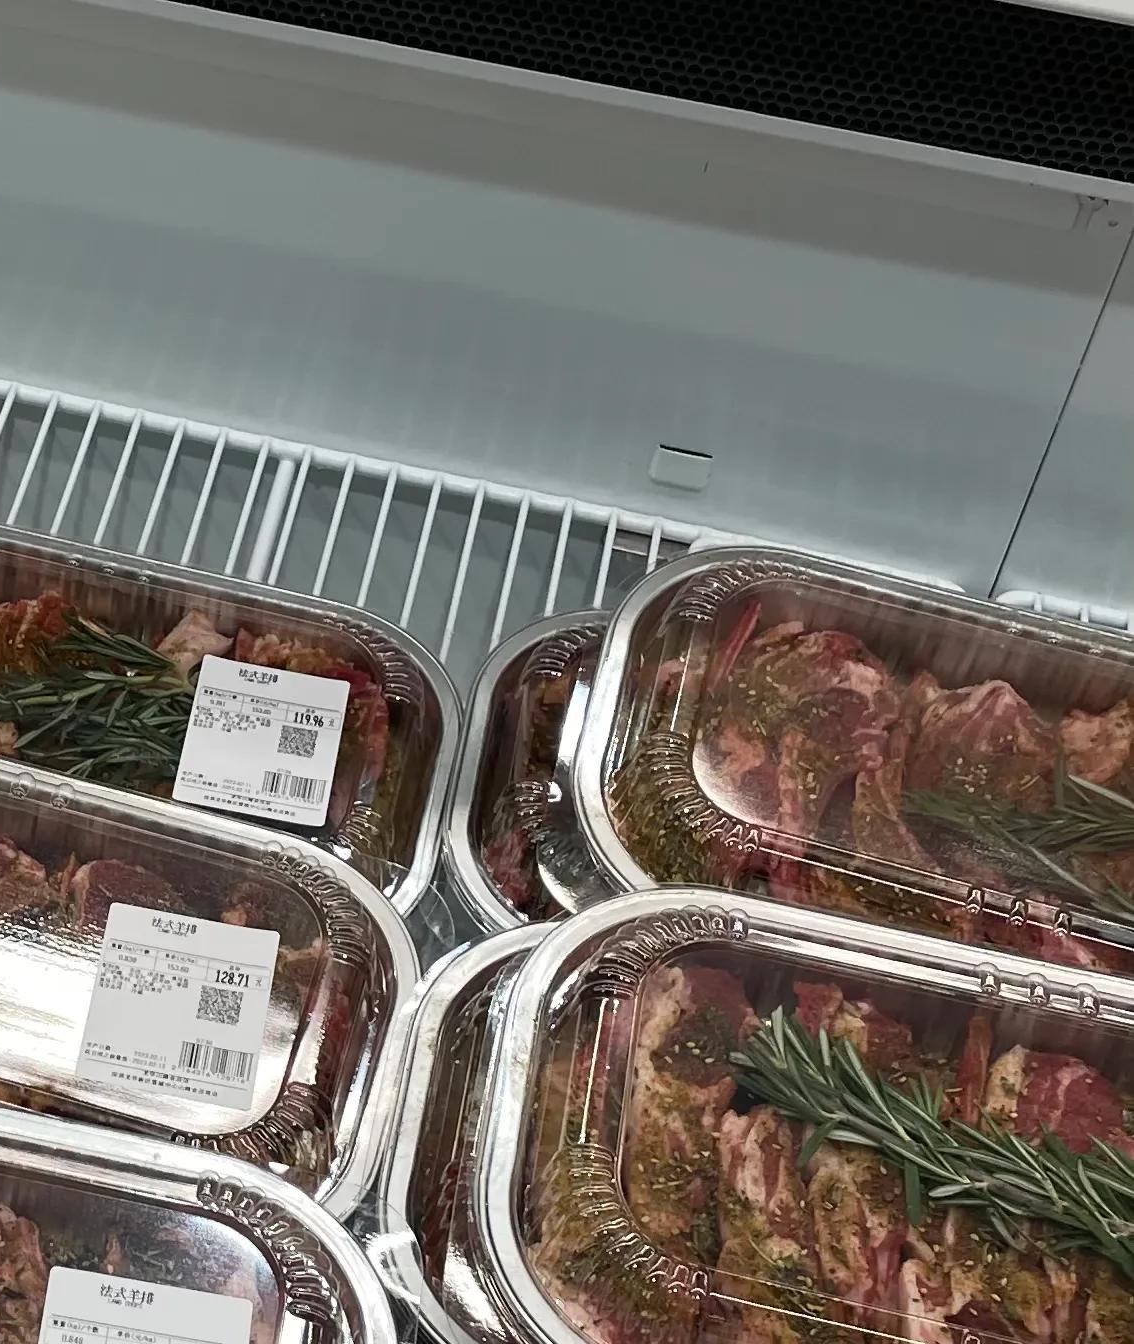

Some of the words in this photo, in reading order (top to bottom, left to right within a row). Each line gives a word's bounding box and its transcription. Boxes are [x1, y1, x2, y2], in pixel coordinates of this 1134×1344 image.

[292, 711, 324, 728] 119.96
[215, 968, 251, 988] 128.71
[99, 1283, 155, 1306] 法式羊排
